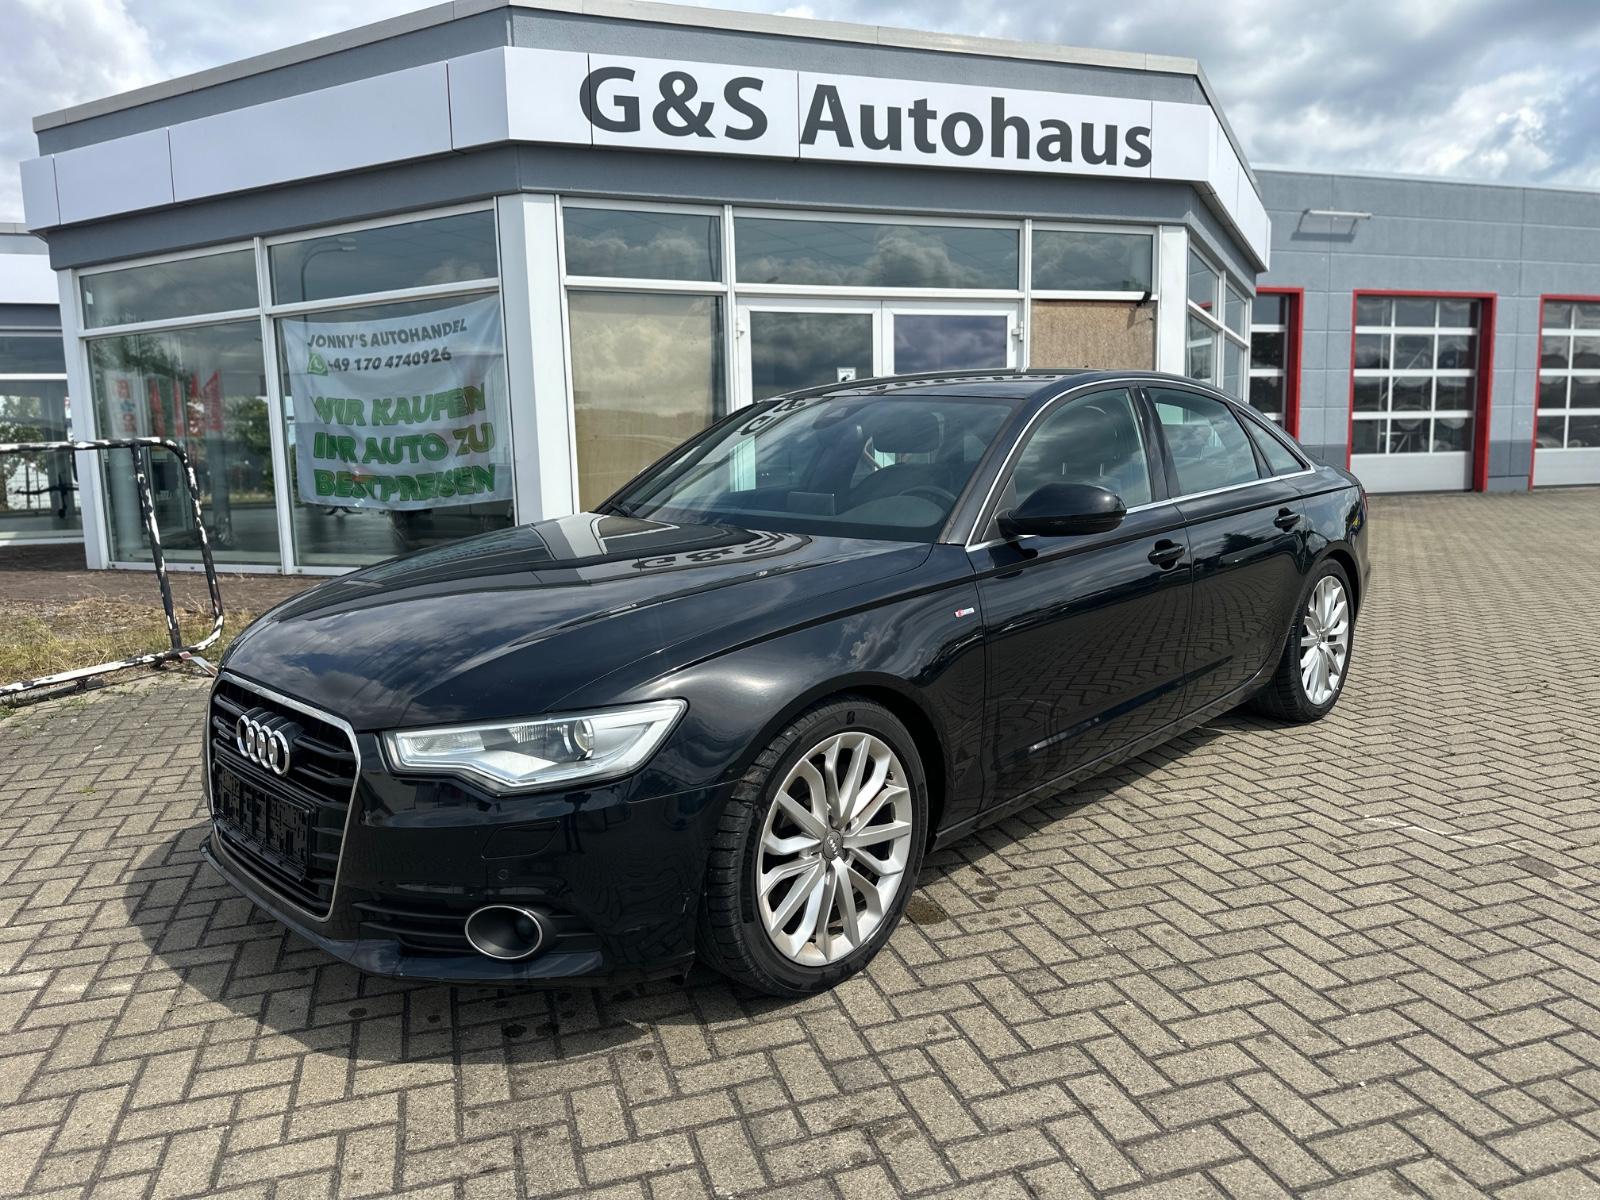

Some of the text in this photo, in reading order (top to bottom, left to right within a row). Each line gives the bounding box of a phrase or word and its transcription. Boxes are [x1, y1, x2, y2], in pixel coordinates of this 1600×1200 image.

[579, 66, 1152, 168] G&S Autohaus
[307, 318, 468, 348] JONNY'S AUTOHANDEL
[354, 356, 383, 371] 170
[384, 347, 452, 369] 4740926
[310, 382, 486, 426] WIR KAUFEN
[362, 432, 449, 465] AUTO
[452, 422, 496, 457] ZU
[313, 463, 496, 502] BESTPREISEN
